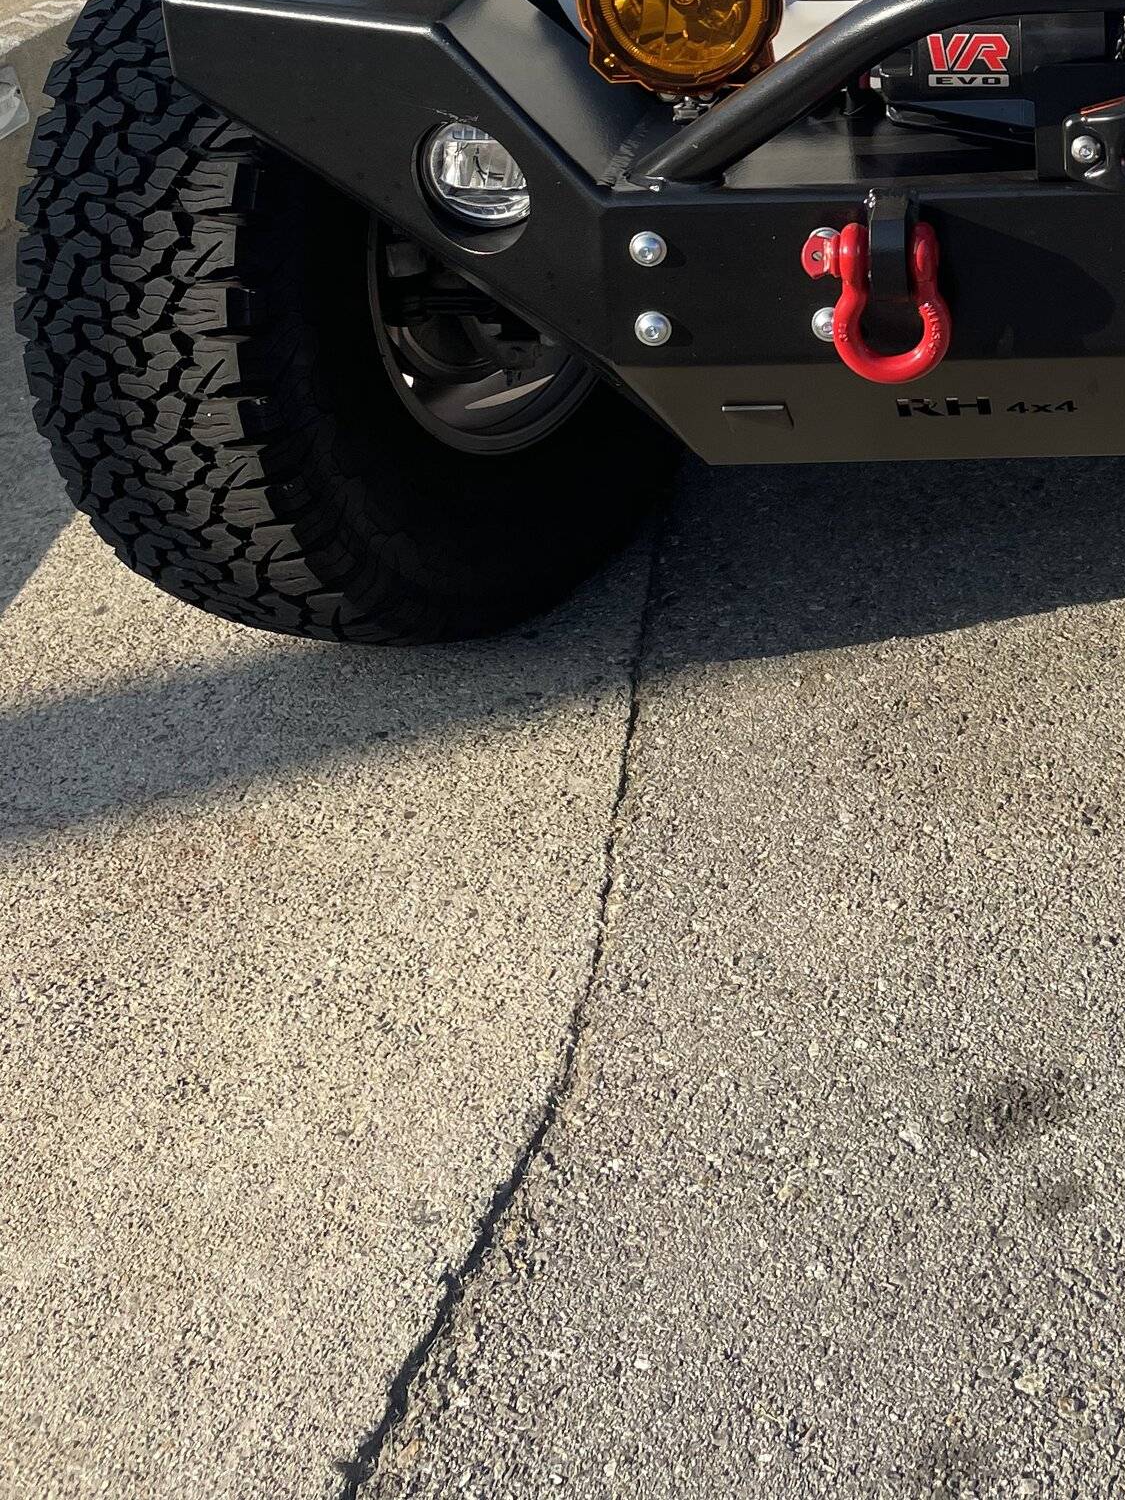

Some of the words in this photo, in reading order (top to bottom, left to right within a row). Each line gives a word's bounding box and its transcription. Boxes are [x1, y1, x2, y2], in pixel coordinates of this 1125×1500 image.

[926, 33, 1011, 72] VR
[935, 76, 1002, 85] EVO
[1006, 400, 1078, 414] 4x4
